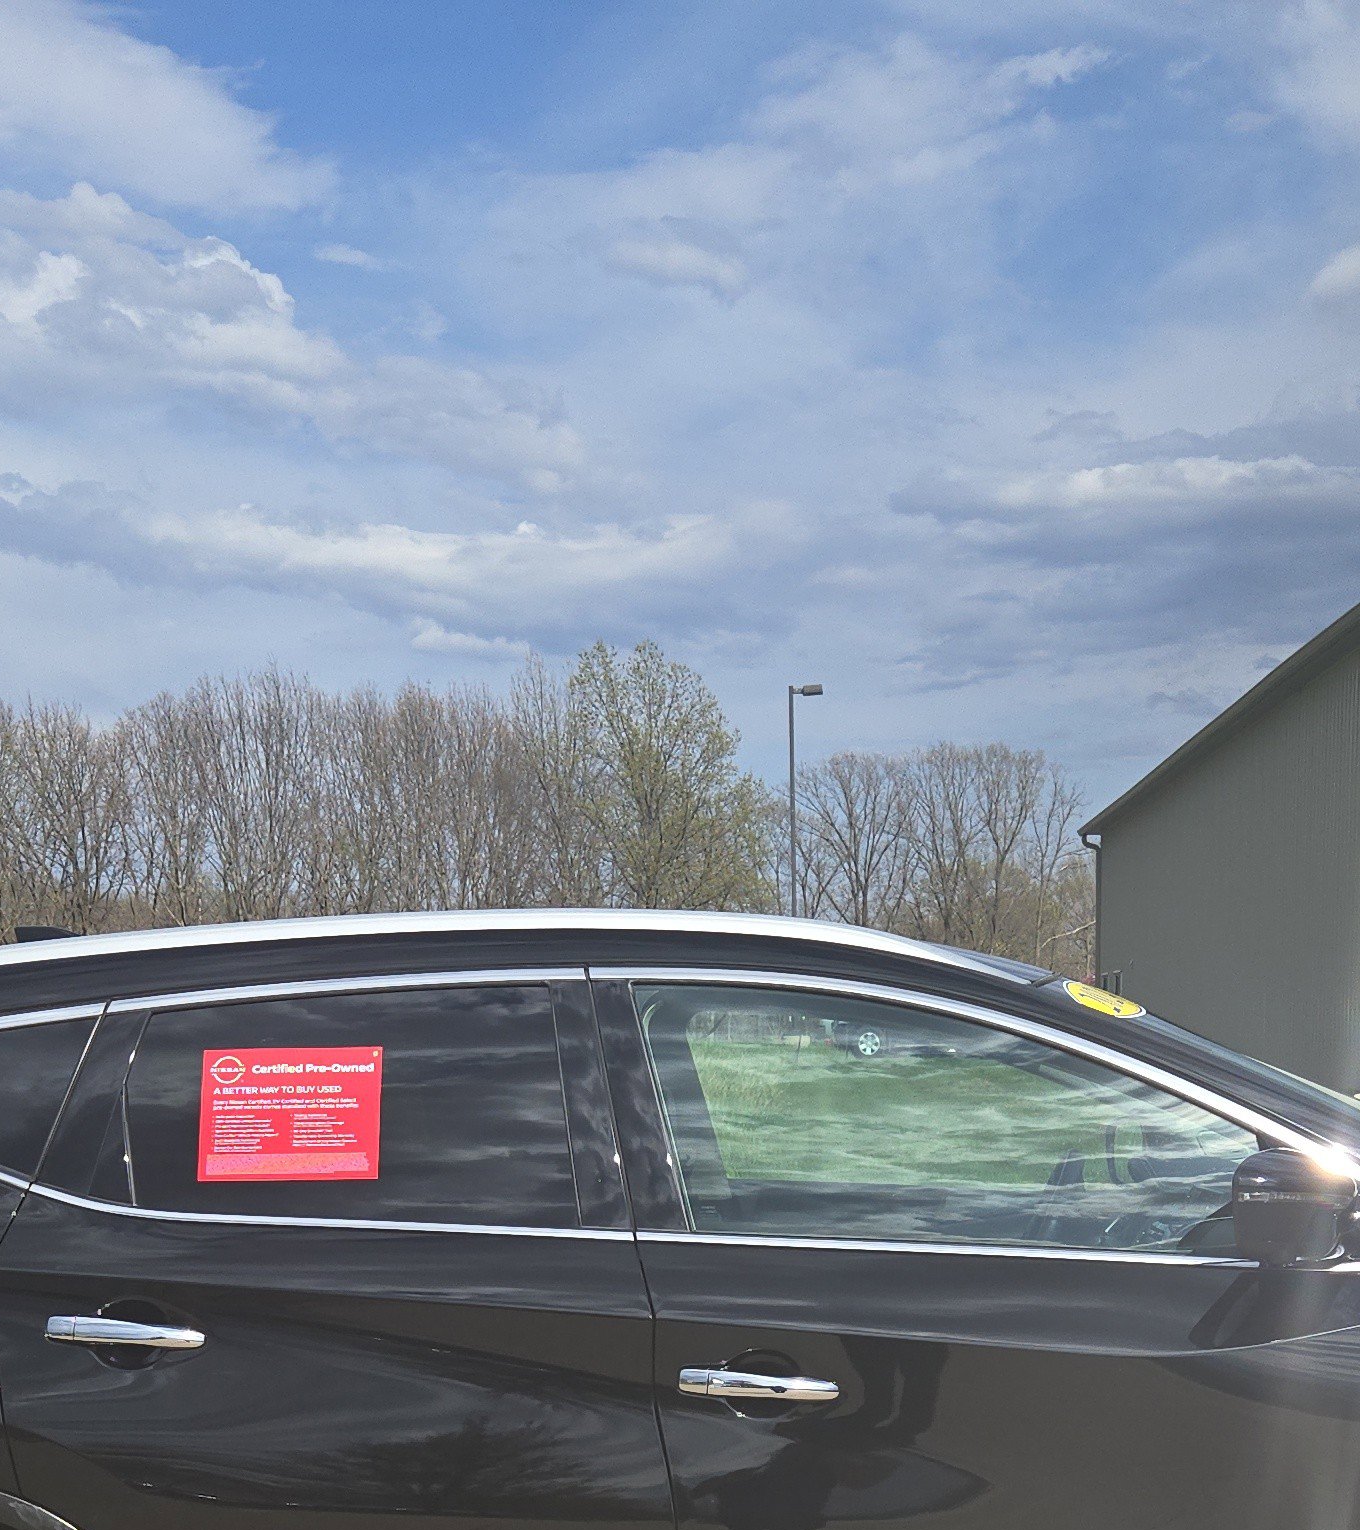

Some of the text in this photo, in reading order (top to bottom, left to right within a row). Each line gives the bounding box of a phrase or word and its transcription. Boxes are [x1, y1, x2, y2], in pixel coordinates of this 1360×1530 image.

[251, 1063, 375, 1074] Certified Pre-Owned
[213, 1087, 221, 1095] A
[222, 1087, 258, 1095] BETTER
[260, 1086, 280, 1094] WAY
